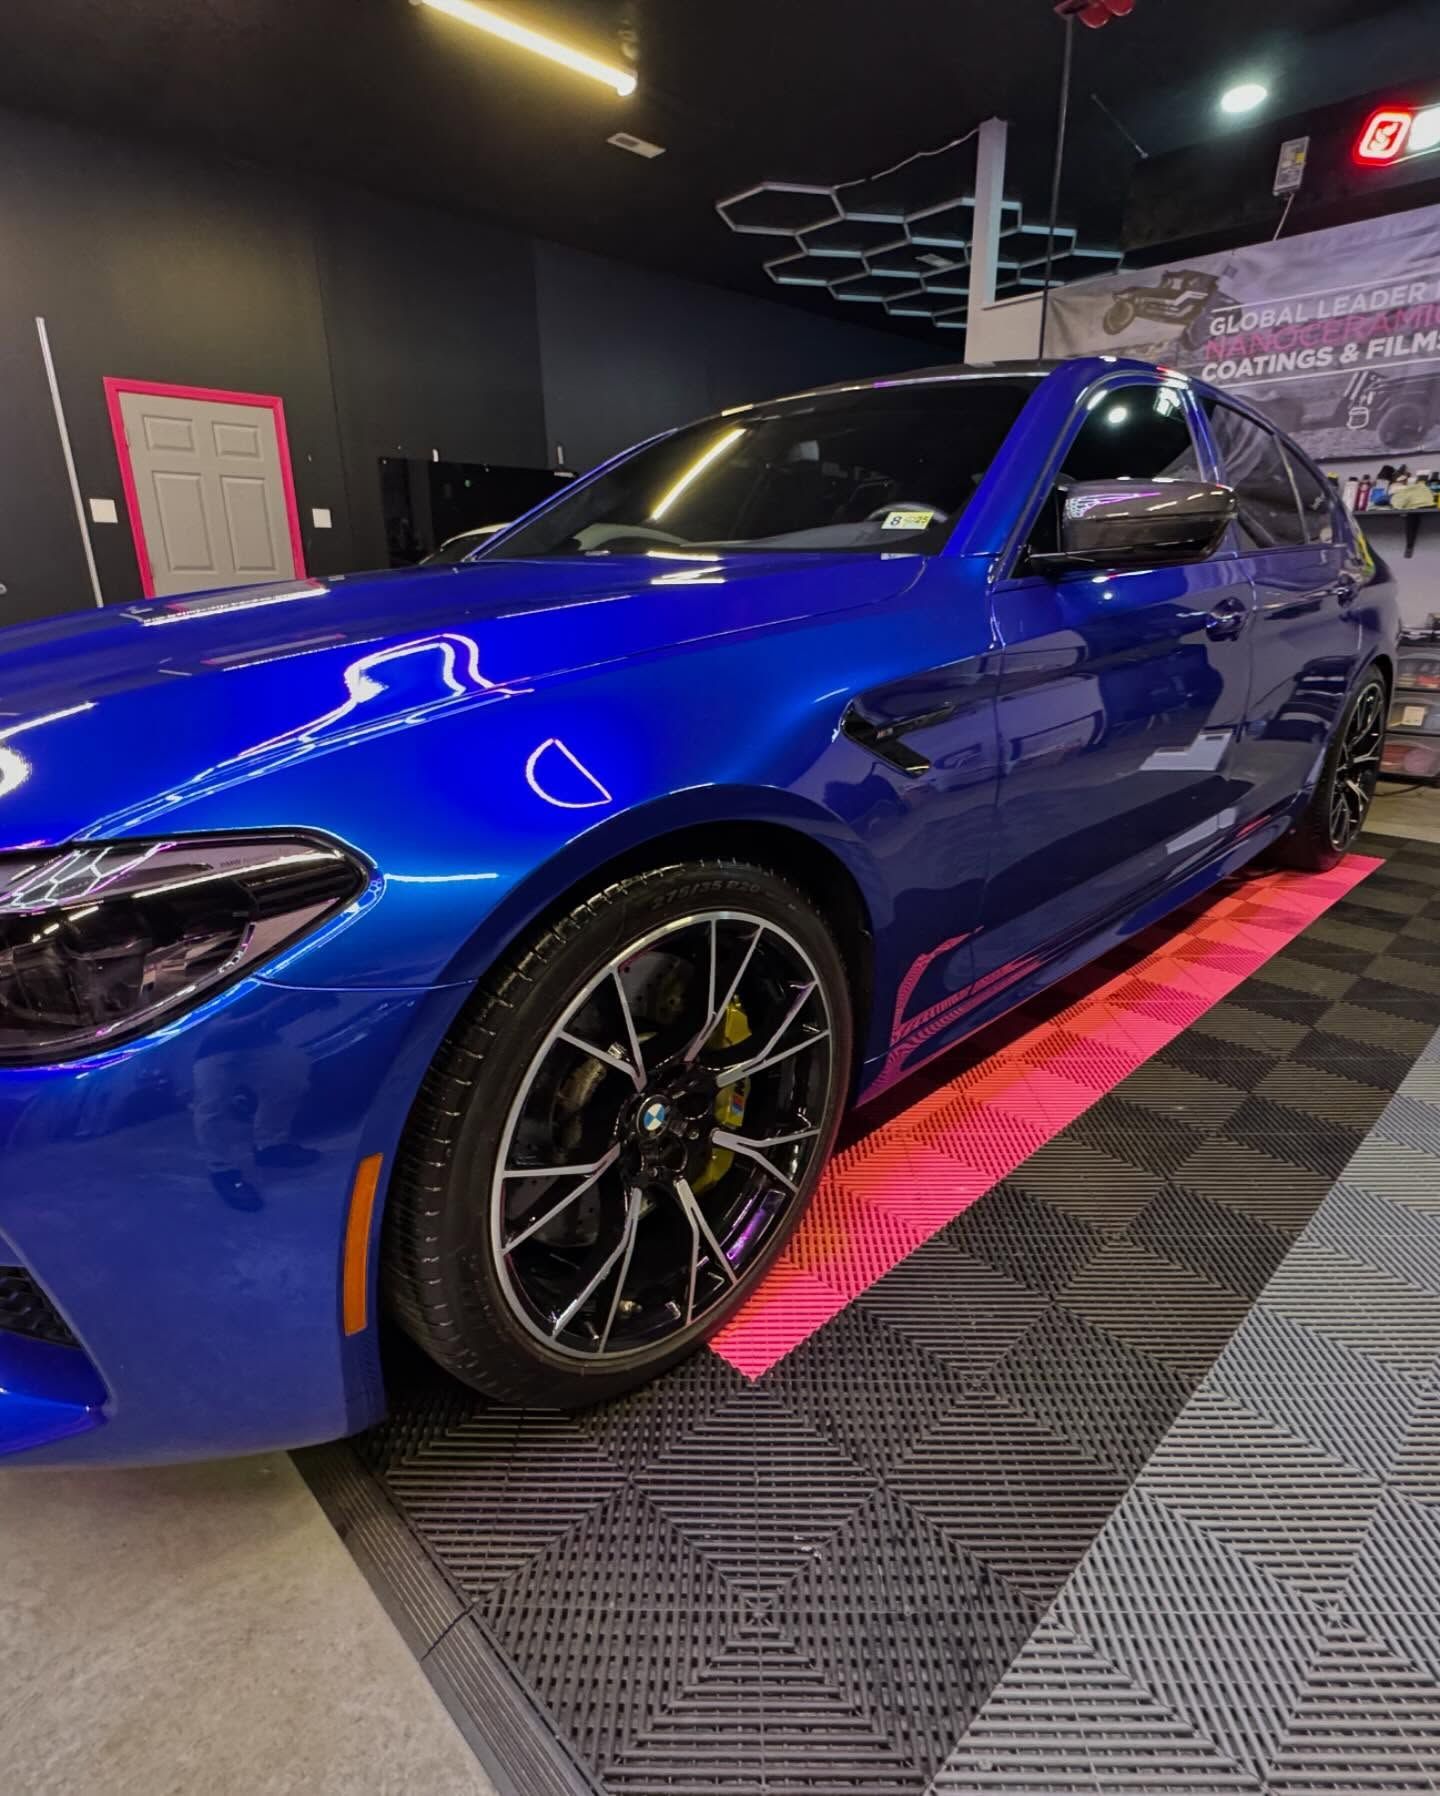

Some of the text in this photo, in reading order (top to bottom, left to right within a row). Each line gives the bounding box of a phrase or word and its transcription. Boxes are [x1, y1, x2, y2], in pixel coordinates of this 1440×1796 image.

[1210, 303, 1309, 336] GLOBAL
[1316, 281, 1427, 319] LEADER
[1201, 330, 1440, 381] COATINGS & FILM
[890, 516, 902, 525] 8
